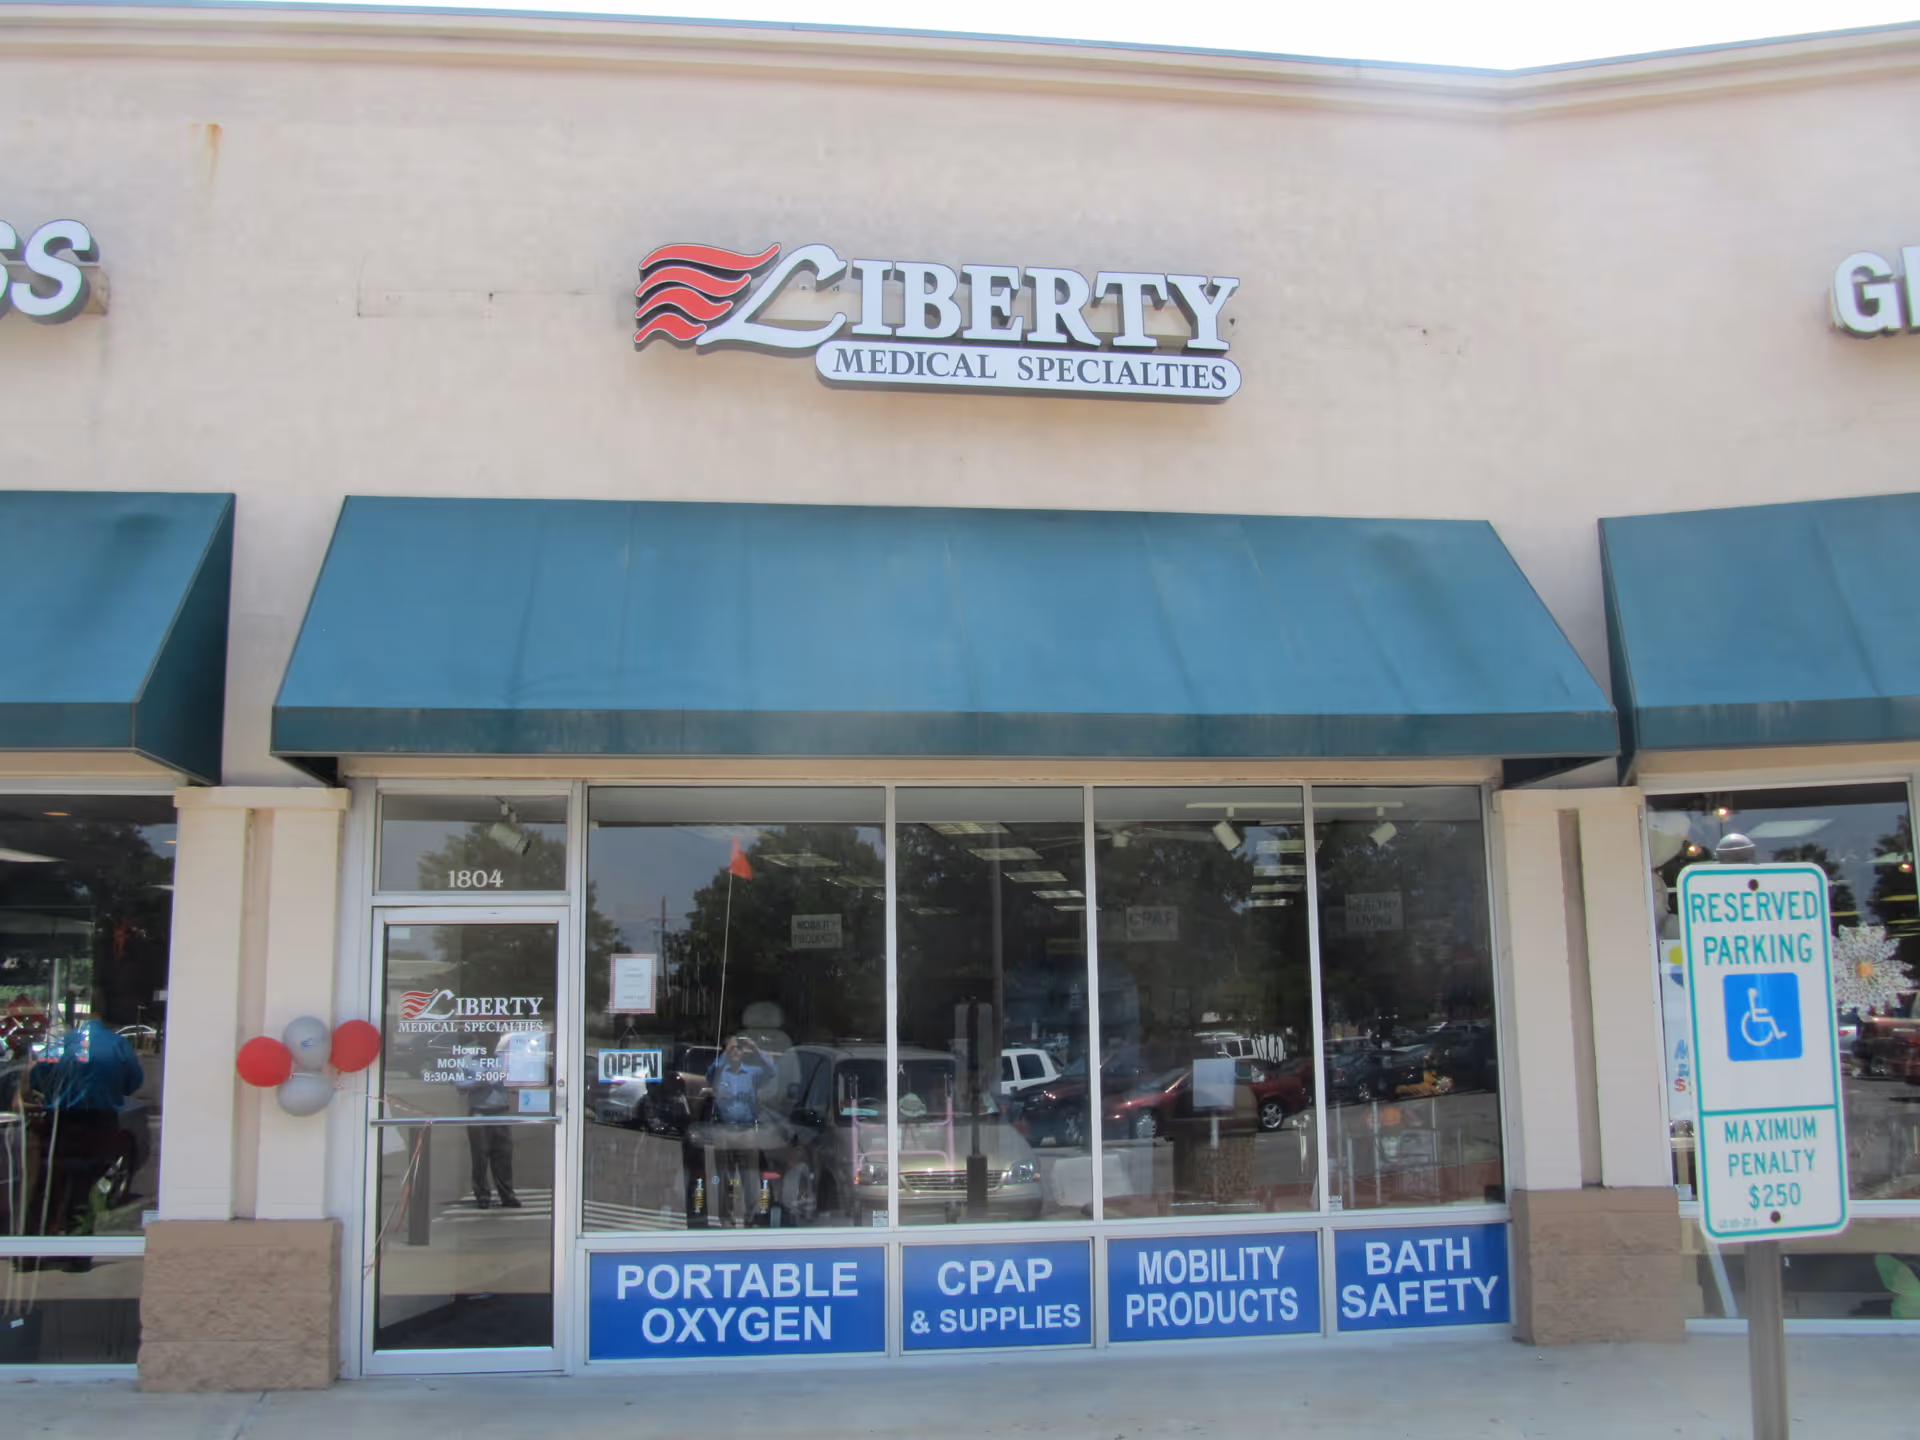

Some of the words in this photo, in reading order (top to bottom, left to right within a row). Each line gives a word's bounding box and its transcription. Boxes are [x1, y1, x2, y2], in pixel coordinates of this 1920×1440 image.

[0, 219, 91, 316] S
[696, 243, 1240, 351] LIBERTY
[832, 347, 997, 379] MEDICAL
[1017, 356, 1227, 391] SPECIALTIES
[447, 869, 504, 888] 1804
[1690, 890, 1818, 924] RESERVED
[1703, 933, 1813, 966] PARKING
[416, 989, 544, 1019] LIBERTY
[398, 1022, 458, 1033] MEDICAL
[464, 1021, 544, 1033] SPECIALTIES
[437, 1058, 468, 1069] MON.
[479, 1058, 502, 1068] FRI.
[452, 1045, 487, 1055] Hours
[603, 1053, 659, 1079] OPEN
[423, 1072, 465, 1082] 8:30AM
[475, 1071, 511, 1082] 5:00P
[1724, 1116, 1817, 1144] MAXIMUM
[1728, 1149, 1815, 1177] PENALTY
[1748, 1183, 1802, 1210] $250
[1138, 1246, 1285, 1285] MOBILITY
[1365, 1237, 1471, 1276] BATH
[616, 1262, 859, 1300] PORTABLE
[937, 1258, 1053, 1296] CPAP
[1126, 1287, 1299, 1328] PRODUCTS
[1342, 1276, 1499, 1319] SAFETY
[642, 1305, 832, 1344] OXYGEN
[910, 1310, 931, 1335] &
[939, 1304, 1082, 1333] SUPPLIES
